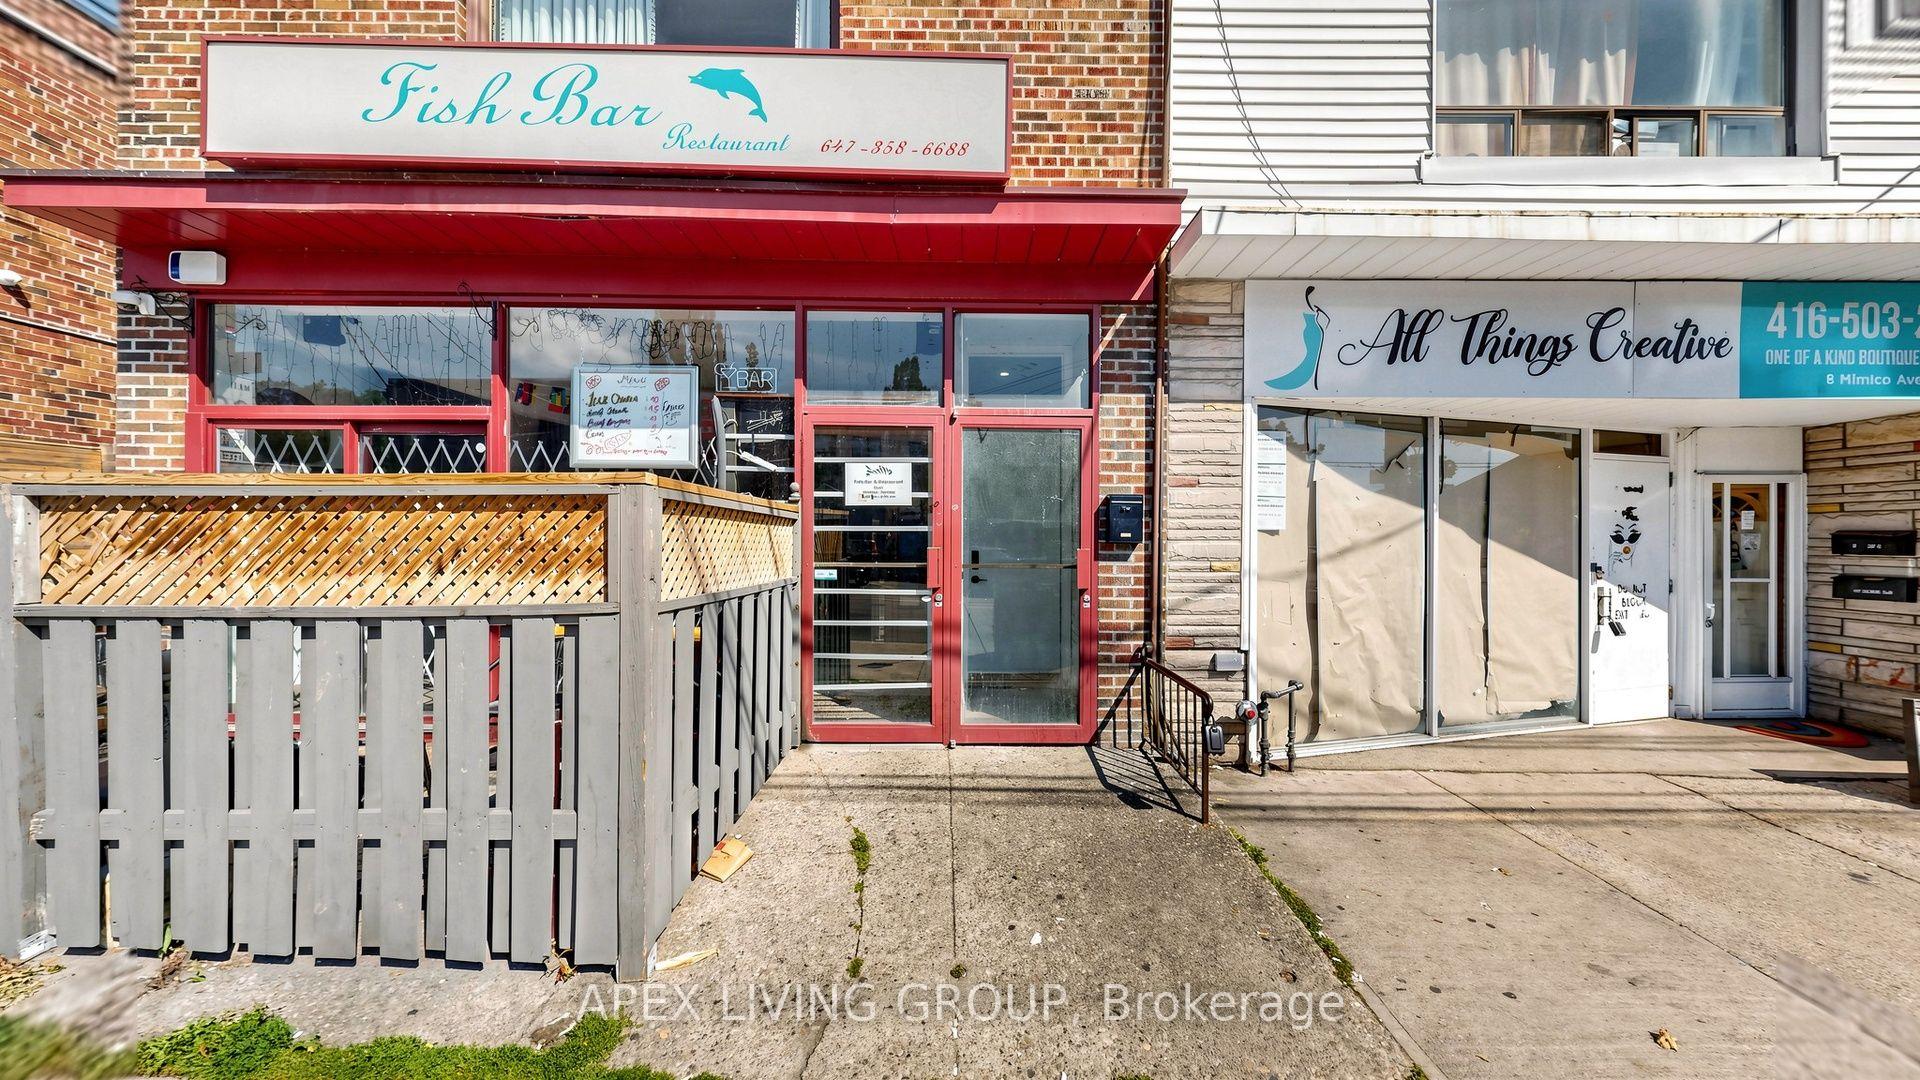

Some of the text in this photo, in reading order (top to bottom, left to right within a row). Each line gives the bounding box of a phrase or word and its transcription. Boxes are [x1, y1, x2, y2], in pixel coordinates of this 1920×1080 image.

[361, 61, 663, 127] Fish Bar
[663, 122, 791, 152] Restaurant
[1766, 301, 1920, 339] 416-503-
[1337, 306, 1734, 377] All Things Creative
[1765, 349, 1920, 366] ONE OF A KIND BOUTIQUE
[736, 370, 774, 391] BAR
[1826, 373, 1835, 385] 8
[1839, 373, 1891, 385] Mimico
